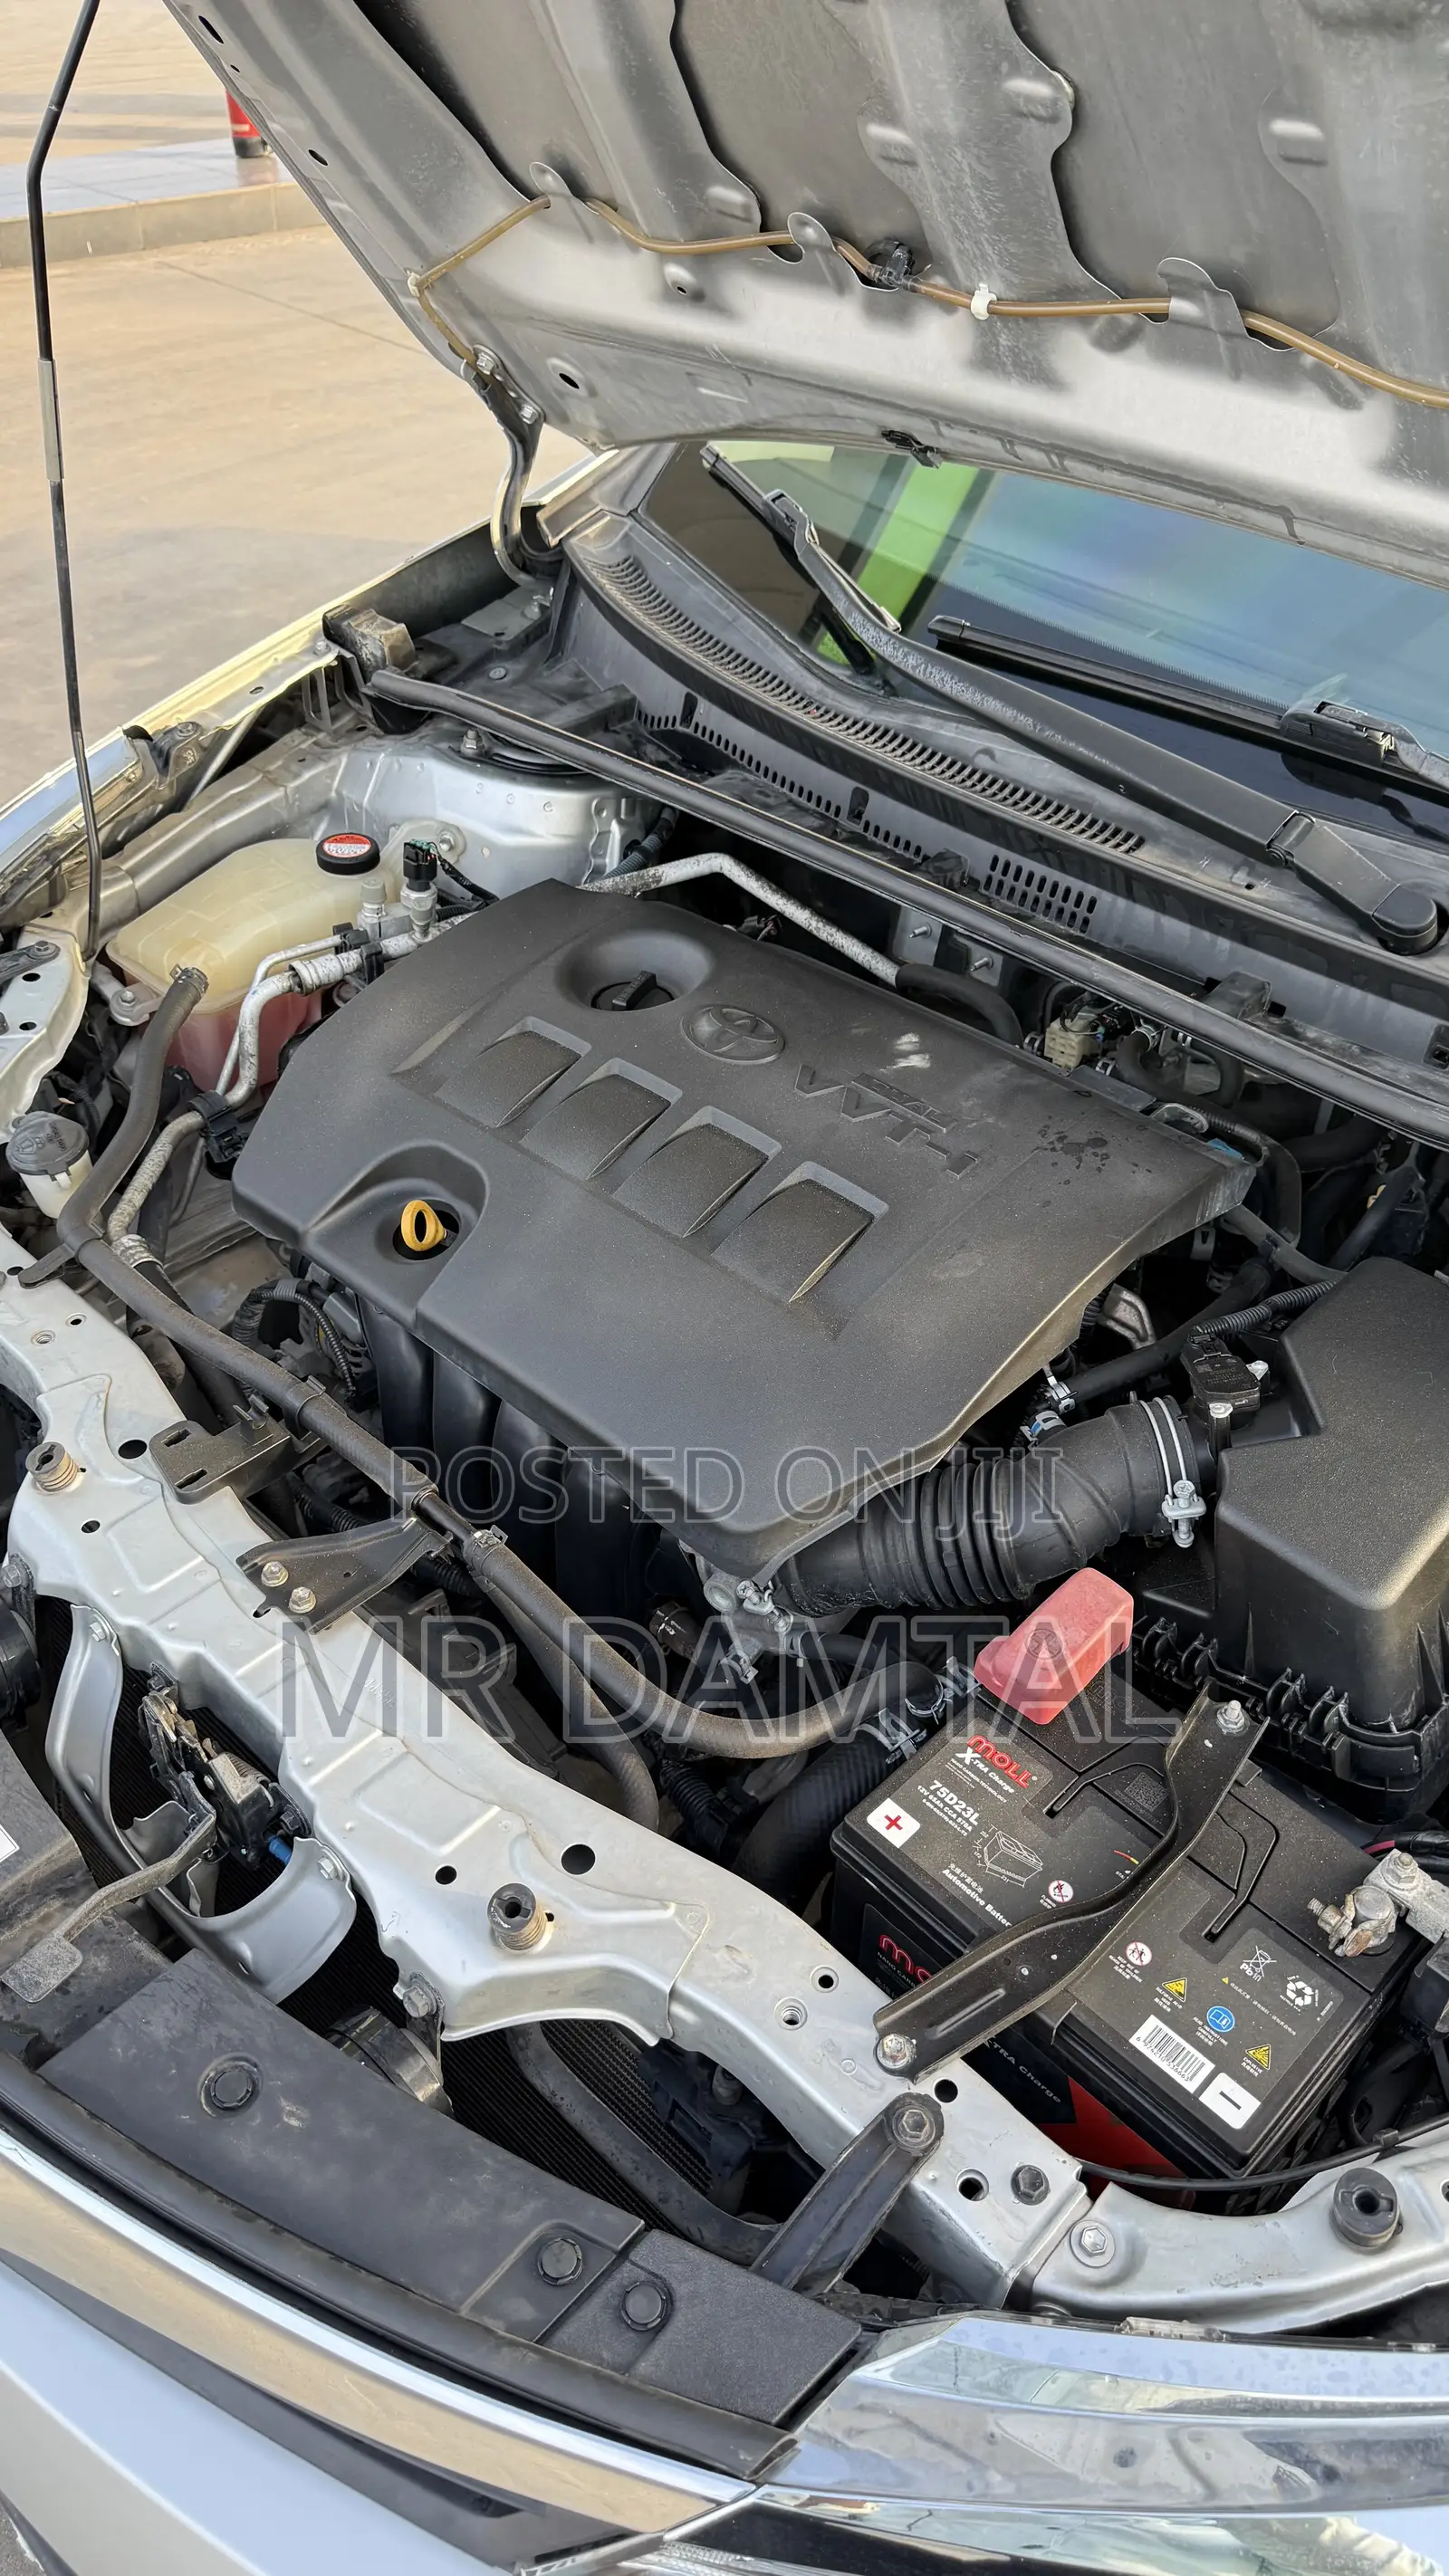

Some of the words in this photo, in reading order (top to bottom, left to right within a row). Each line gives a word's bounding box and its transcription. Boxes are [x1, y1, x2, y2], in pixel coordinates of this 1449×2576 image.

[955, 1743, 992, 1776] X-TRA
[985, 1769, 1016, 1796] Charge
[916, 1784, 929, 1796] 12V
[942, 1805, 957, 1819] CCA
[927, 1778, 983, 1825] 75D23L
[940, 1866, 987, 1906] Automotive
[983, 1901, 1014, 1929] Batter
[1016, 2064, 1064, 2104] Charge
